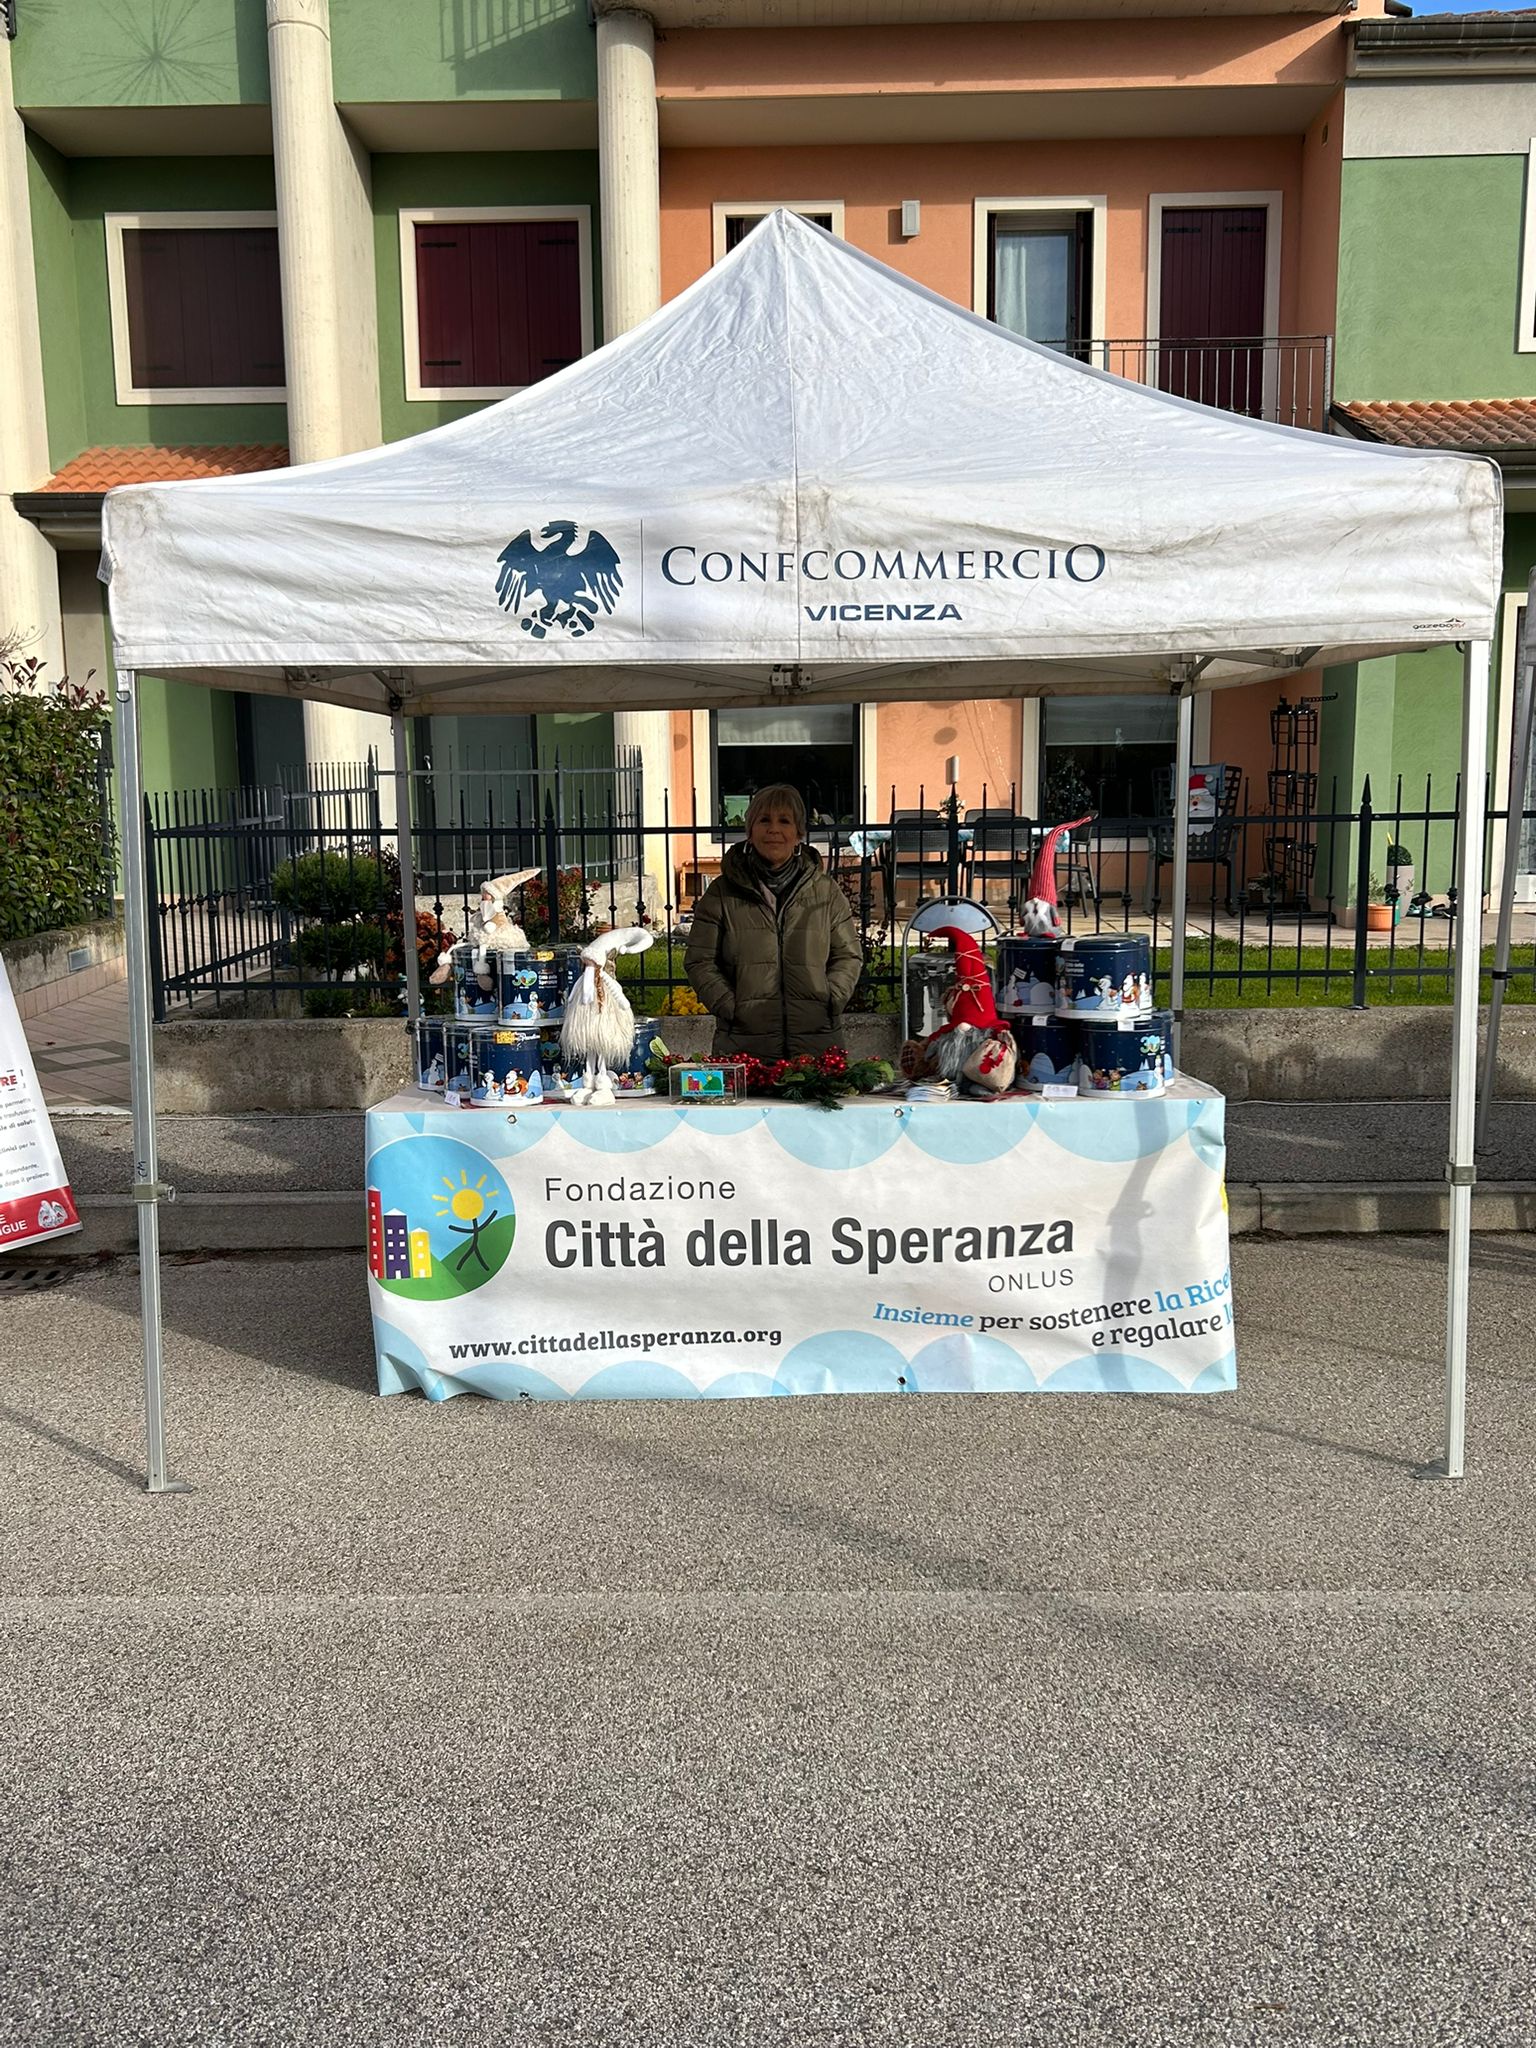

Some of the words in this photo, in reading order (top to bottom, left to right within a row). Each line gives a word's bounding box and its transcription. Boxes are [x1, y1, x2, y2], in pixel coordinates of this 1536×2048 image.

[804, 603, 963, 622] VICENZA
[545, 1176, 736, 1202] Fondazione
[545, 1217, 665, 1268] Città
[686, 1218, 811, 1267] della
[831, 1216, 1074, 1275] Speranza
[988, 1268, 1074, 1293] ONLUS
[872, 1302, 974, 1327] Insieme
[978, 1314, 1023, 1334] per
[1029, 1298, 1151, 1331] sostenere
[1154, 1290, 1184, 1312] la
[1184, 1262, 1230, 1307] Rice
[448, 1329, 783, 1360] www.cittadellasperanza.org
[1091, 1331, 1105, 1347] e
[1110, 1313, 1223, 1349] regalare
